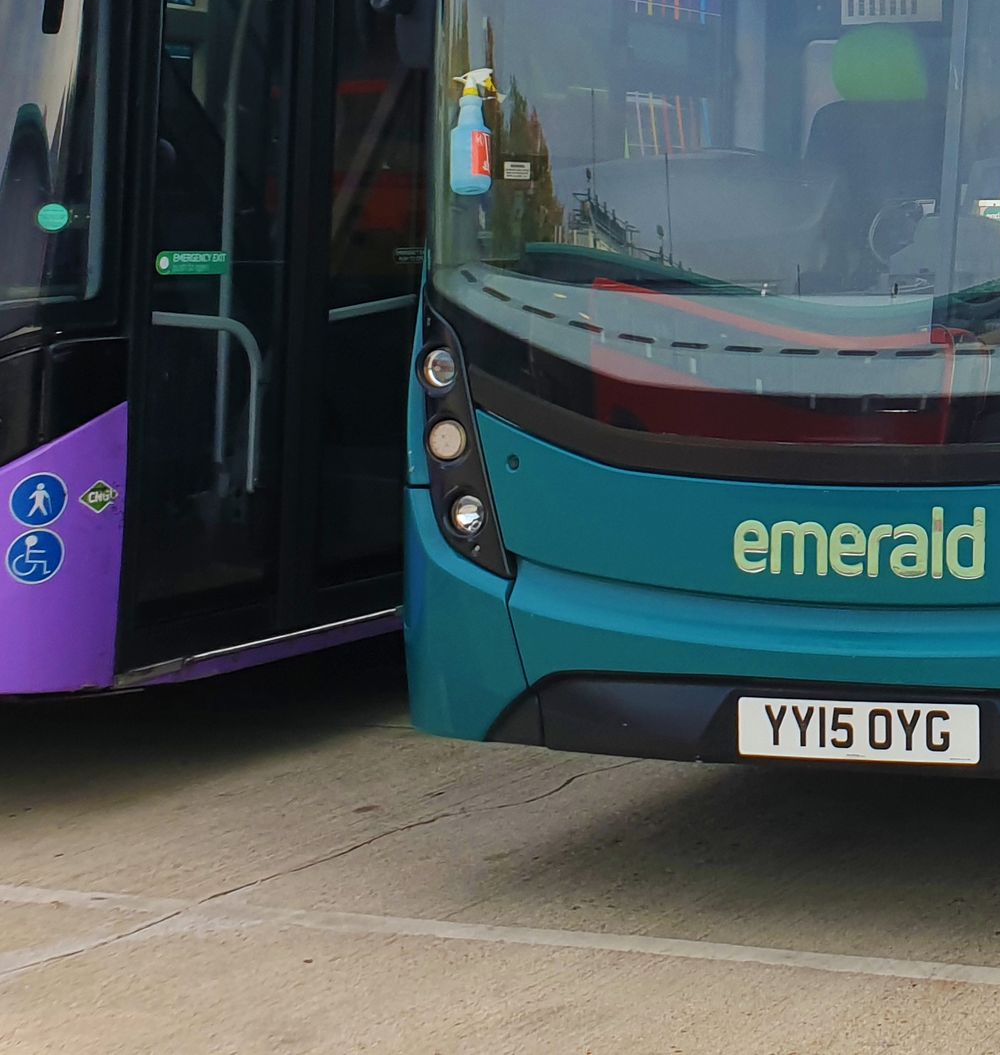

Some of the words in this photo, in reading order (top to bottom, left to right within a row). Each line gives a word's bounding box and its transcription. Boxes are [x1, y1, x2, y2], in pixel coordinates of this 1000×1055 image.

[733, 506, 986, 579] emerald
[765, 704, 854, 749] YY15
[868, 709, 950, 752] OYG
